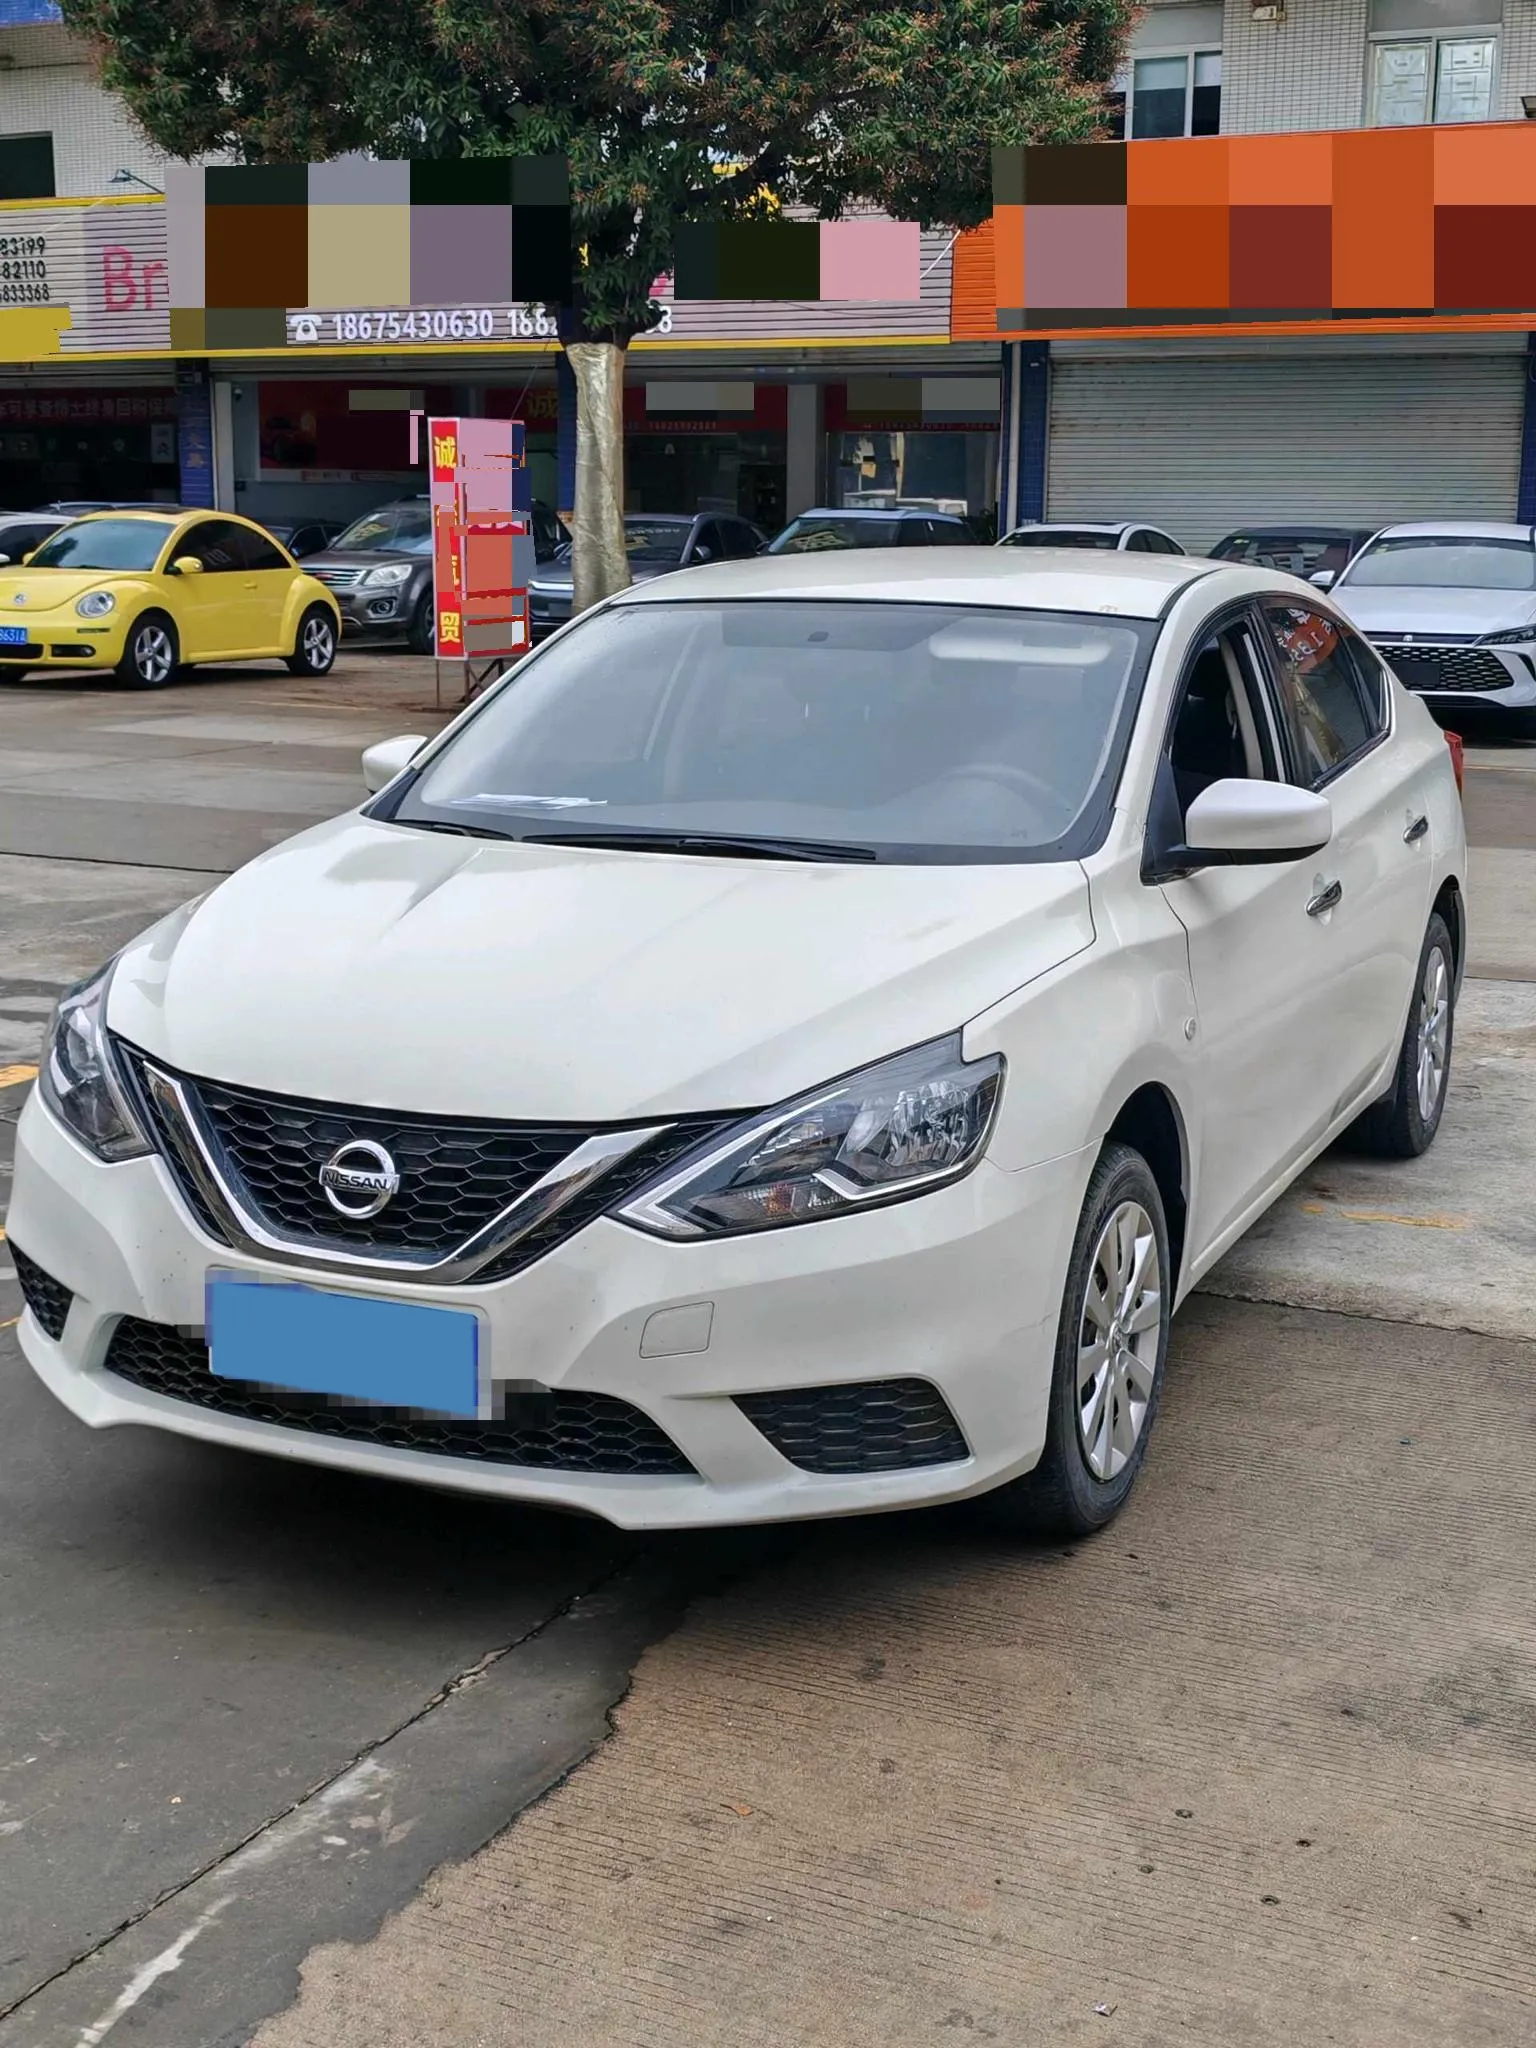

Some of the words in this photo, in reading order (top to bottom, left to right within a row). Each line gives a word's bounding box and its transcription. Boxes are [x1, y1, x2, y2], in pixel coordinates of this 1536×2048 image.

[103, 245, 169, 312] Br
[0, 283, 50, 303] 833368
[332, 309, 494, 341] 18675430630
[324, 1170, 387, 1190] NISSAN
